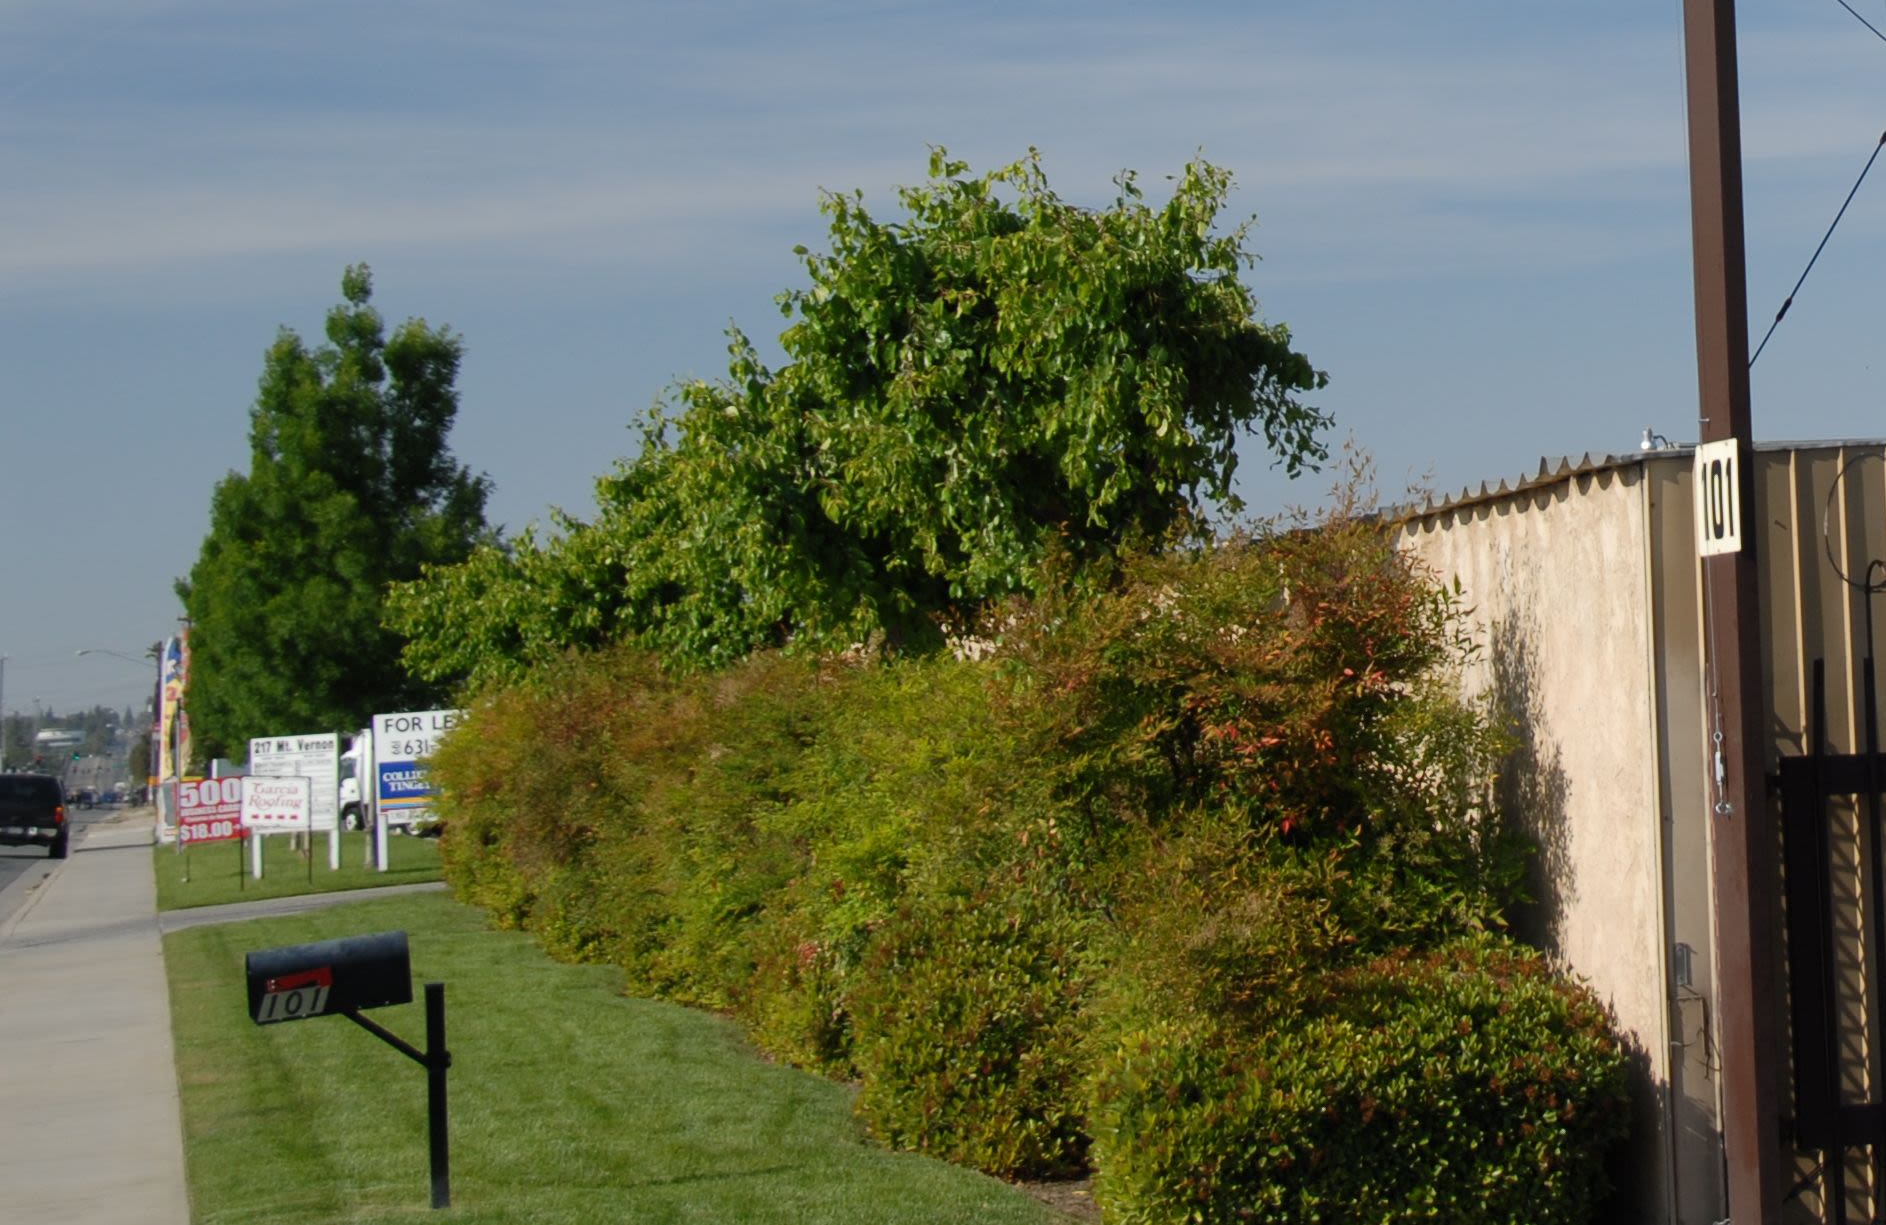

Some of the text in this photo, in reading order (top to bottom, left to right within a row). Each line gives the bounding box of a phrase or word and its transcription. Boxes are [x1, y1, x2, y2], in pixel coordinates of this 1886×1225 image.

[1701, 457, 1735, 541] 101
[384, 715, 454, 733] FOR LE
[254, 741, 271, 754] 217
[297, 738, 334, 751] Vernon
[180, 778, 241, 807] 500
[252, 782, 298, 795] Garcia
[249, 795, 303, 810] Roofing
[267, 987, 321, 1018] 101
